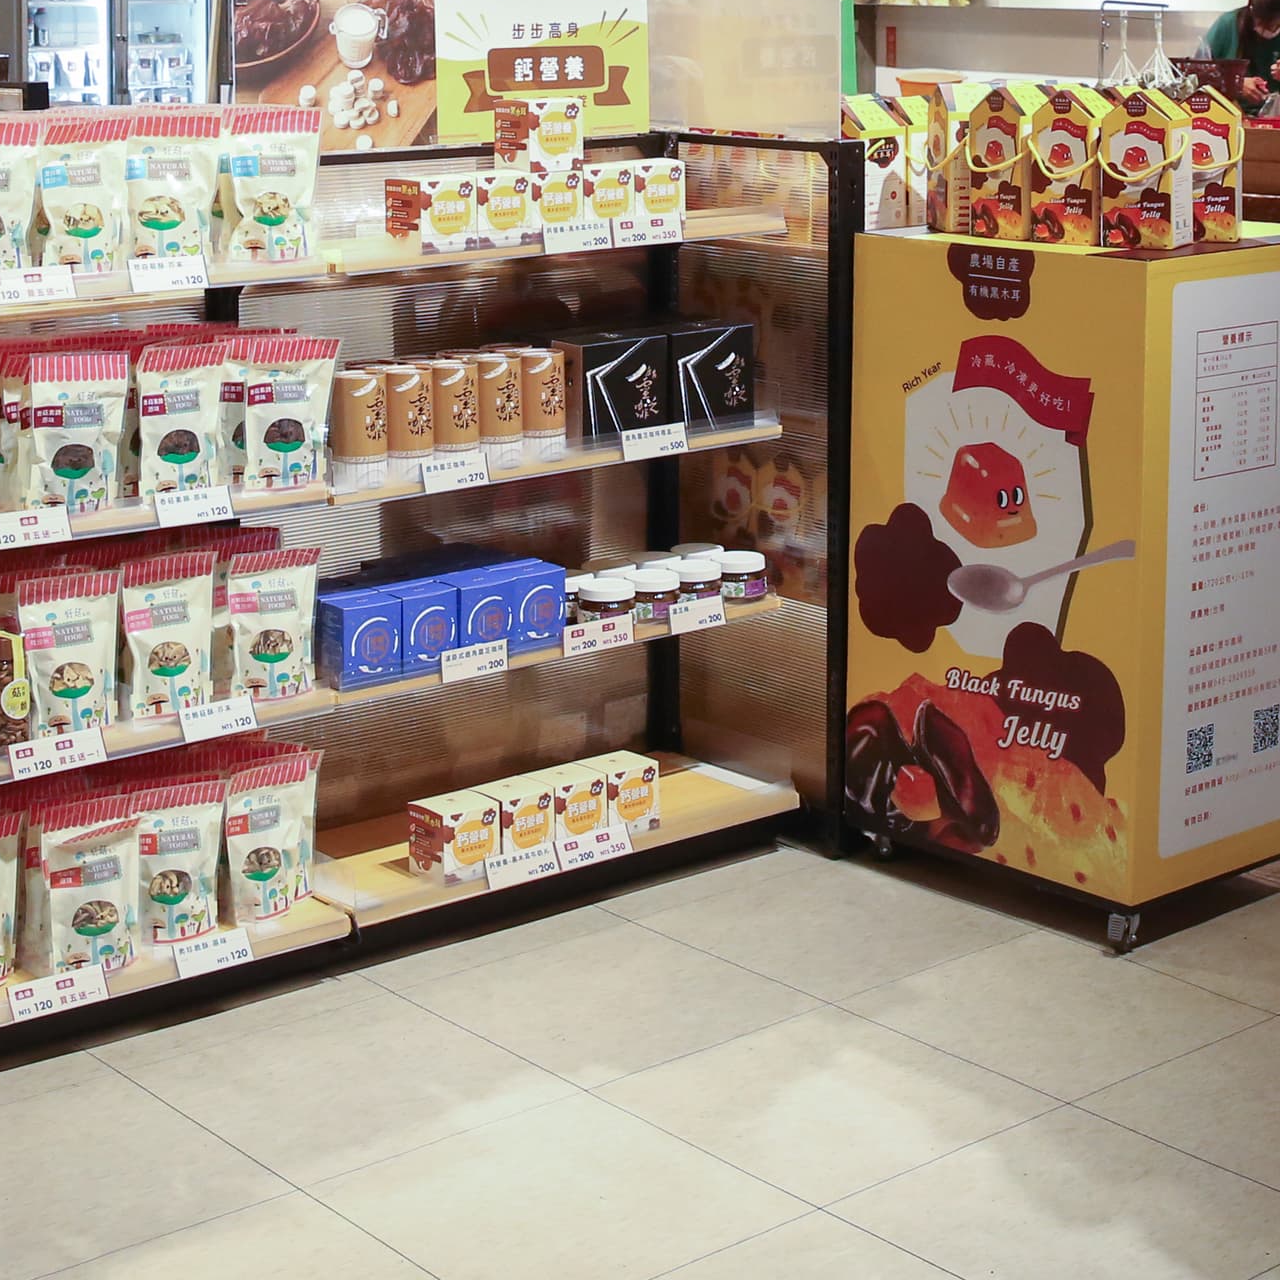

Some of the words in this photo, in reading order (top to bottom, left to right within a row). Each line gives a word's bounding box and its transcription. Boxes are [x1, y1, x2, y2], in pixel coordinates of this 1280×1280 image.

[512, 22, 580, 40] 步步高身
[514, 55, 585, 82] 鈣營養
[593, 236, 608, 245] 200
[632, 233, 646, 241] 200
[662, 230, 677, 239] 350
[970, 253, 1019, 272] 農場自產
[185, 275, 203, 285] 120
[1, 290, 20, 300] 120
[969, 285, 1020, 302] 有機黑木耳
[903, 376, 922, 393] Rich
[921, 362, 942, 380] Year
[971, 354, 1071, 412] 冷藏、冷凍更好吃!
[670, 440, 685, 450] 500
[469, 472, 485, 482] 270
[210, 505, 228, 516] 120
[708, 613, 722, 623] 200
[582, 639, 597, 649] 200
[613, 633, 628, 642] 350
[488, 659, 505, 669] 200
[946, 669, 1001, 697] Black
[1008, 679, 1081, 711] Fungus
[235, 716, 252, 727] 120
[997, 716, 1067, 759] Jelly
[33, 759, 52, 771] 120
[579, 851, 594, 862] 200
[610, 843, 626, 854] 350
[539, 862, 555, 872] 200
[231, 948, 248, 960] 120
[34, 999, 53, 1012] 120
